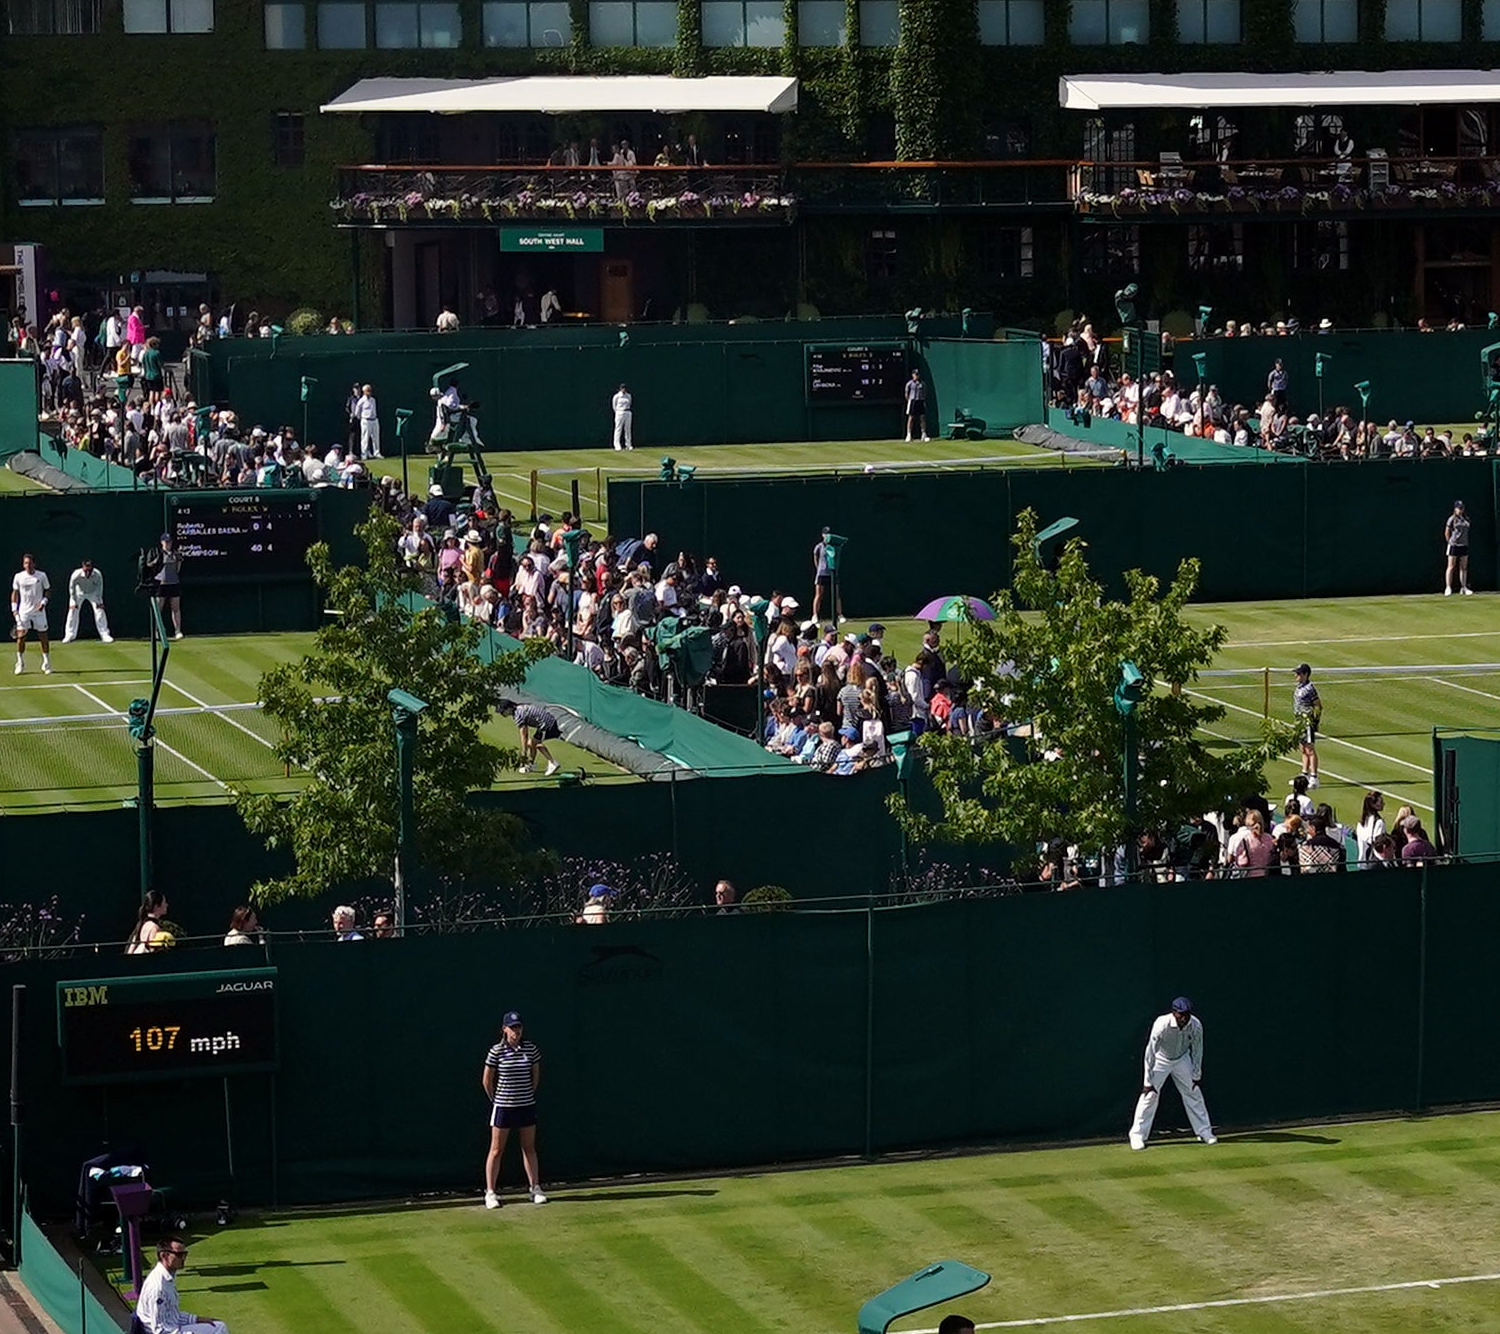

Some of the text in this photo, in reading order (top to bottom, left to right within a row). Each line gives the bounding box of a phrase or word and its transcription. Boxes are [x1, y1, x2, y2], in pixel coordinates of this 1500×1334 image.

[519, 237, 543, 246] SOUTH
[544, 237, 564, 245] WEST
[228, 496, 254, 504] COURT
[216, 980, 274, 993] JAGUAR
[64, 986, 108, 1007] IBM
[129, 1025, 241, 1055] 107 mph
